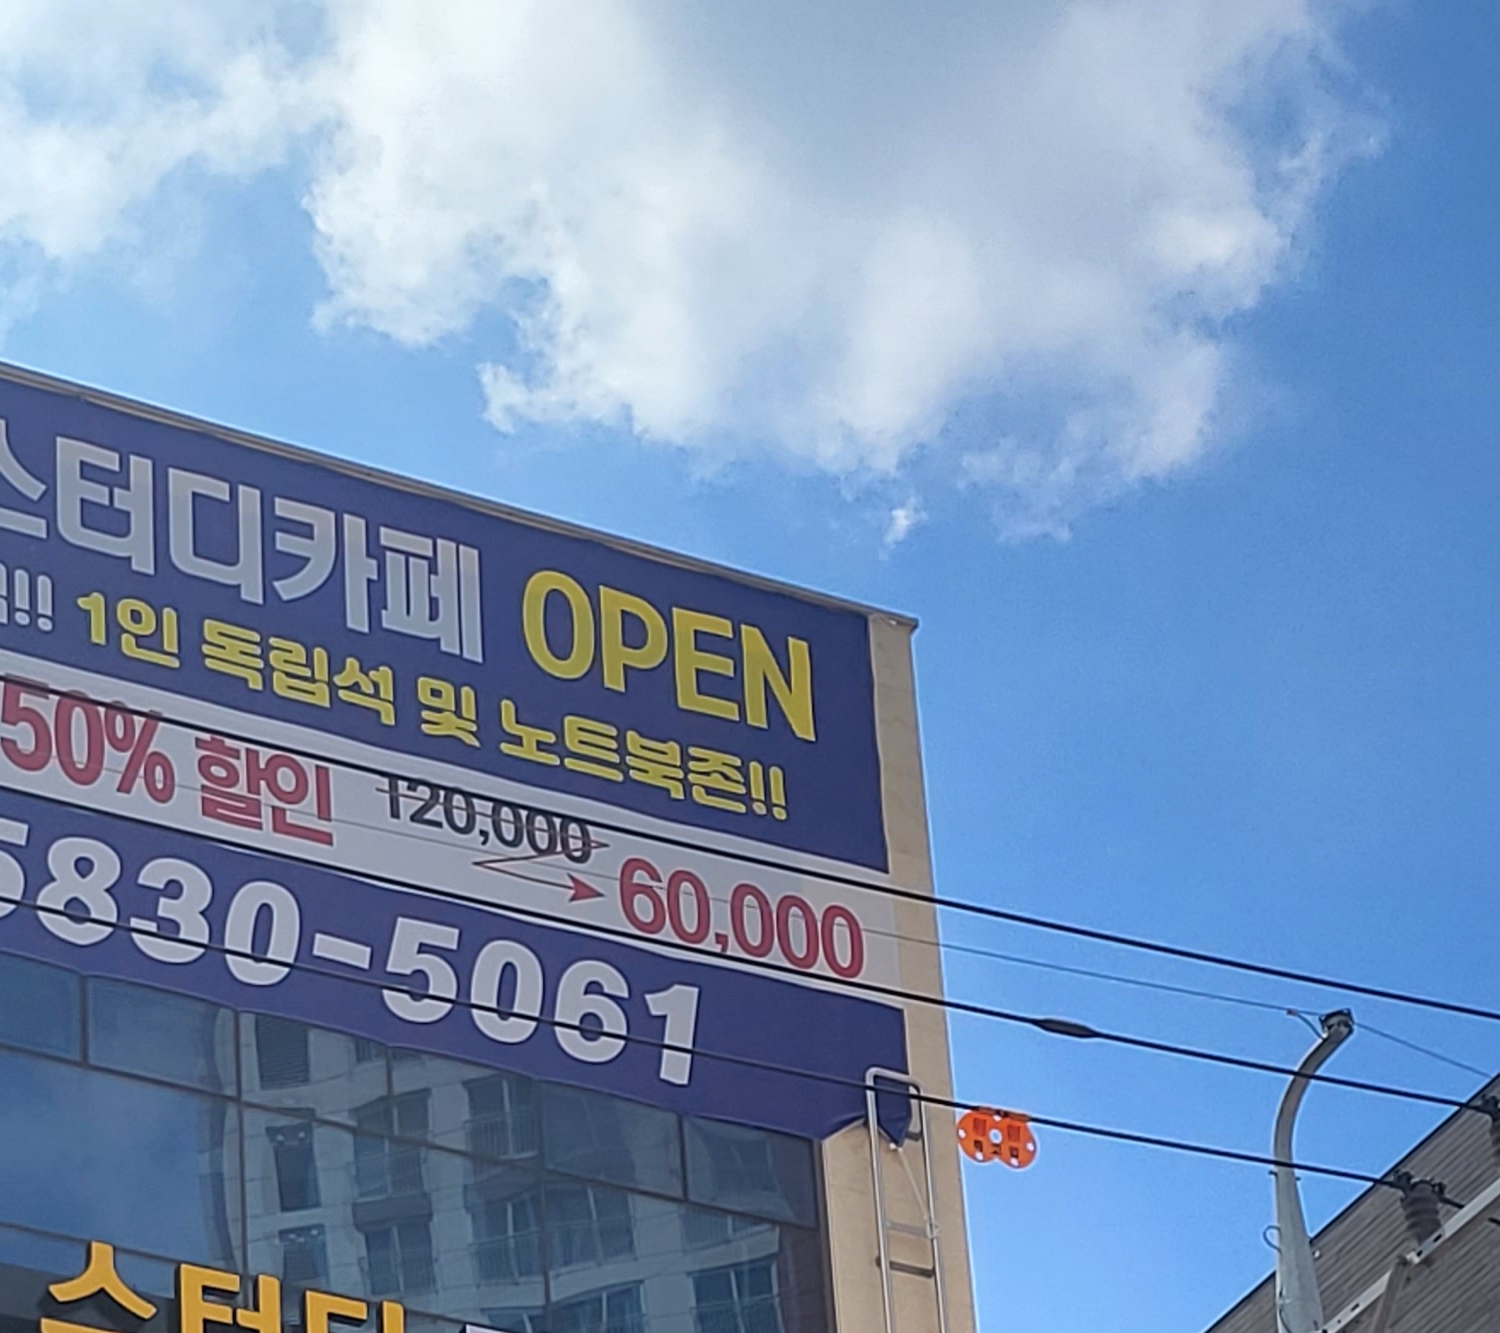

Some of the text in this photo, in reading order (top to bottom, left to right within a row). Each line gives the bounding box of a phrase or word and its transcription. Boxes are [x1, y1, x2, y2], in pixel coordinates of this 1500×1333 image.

[77, 592, 180, 668] 1인
[202, 618, 396, 726] 독립석
[417, 676, 481, 747] 및
[499, 700, 788, 822] 노트북존!!
[521, 568, 817, 742] OPEN
[0, 674, 175, 803] 50%
[195, 734, 333, 847] 할인
[385, 774, 592, 865] 120,000
[619, 857, 864, 979] 60,000
